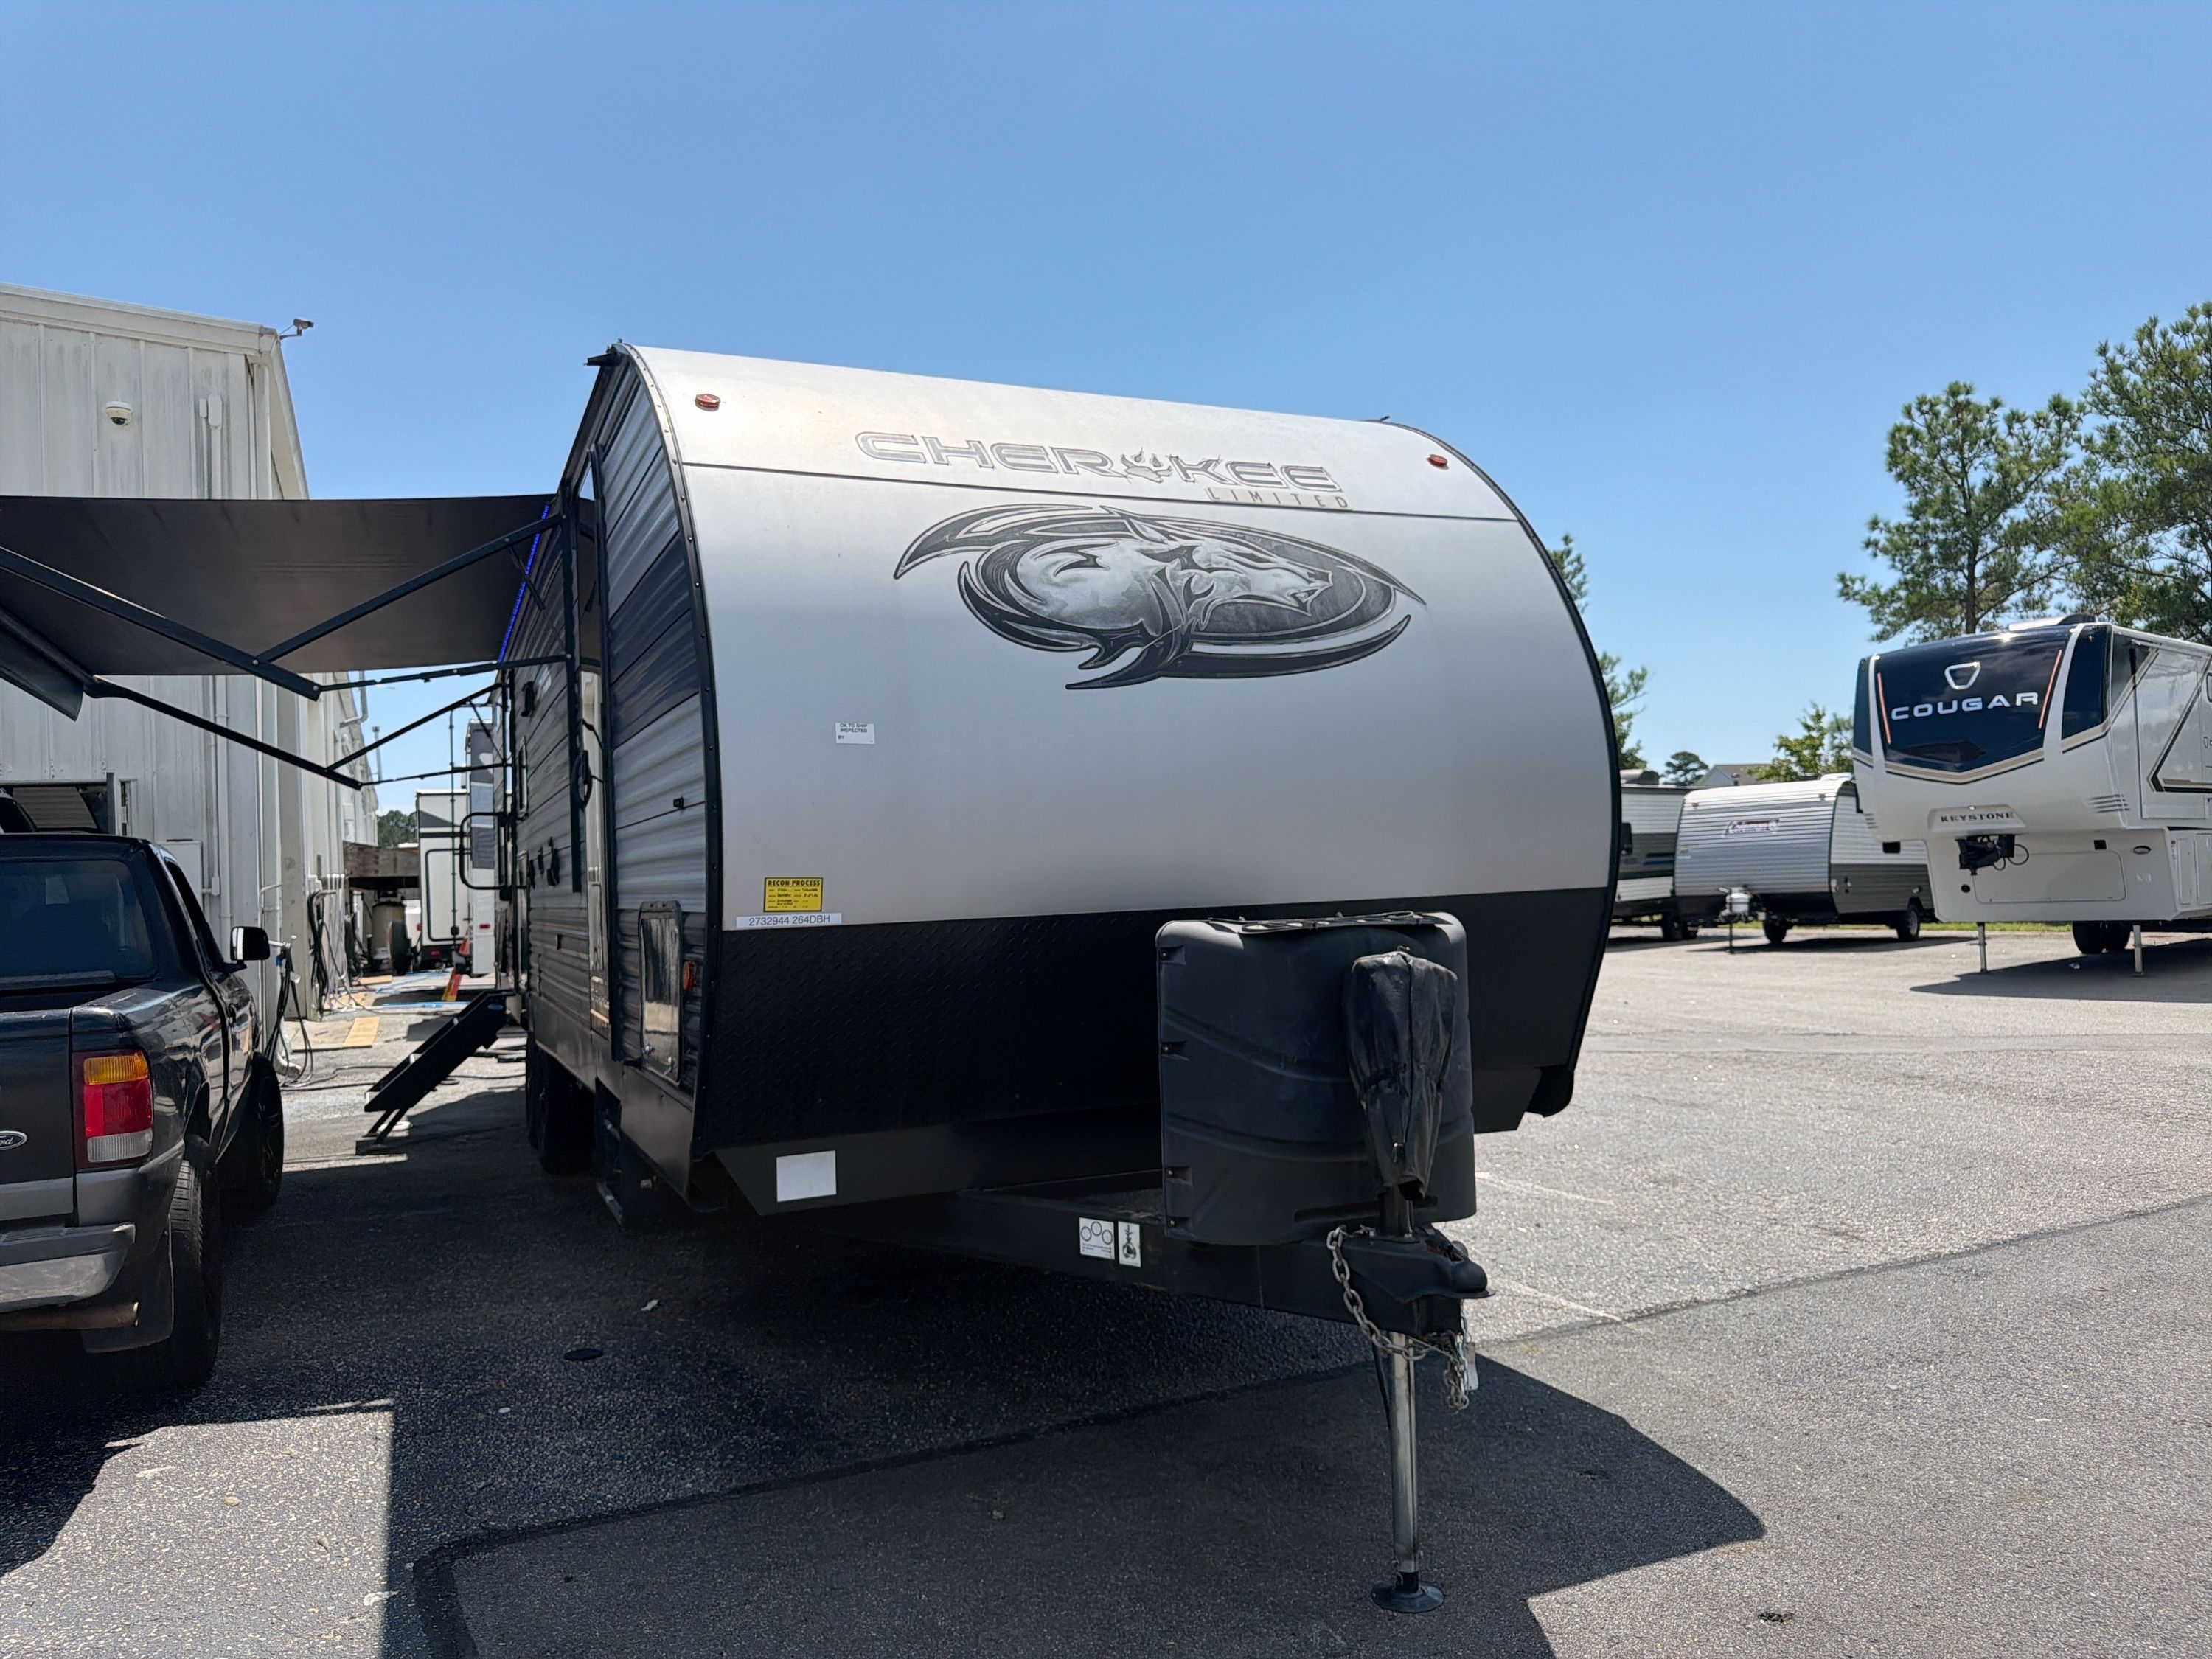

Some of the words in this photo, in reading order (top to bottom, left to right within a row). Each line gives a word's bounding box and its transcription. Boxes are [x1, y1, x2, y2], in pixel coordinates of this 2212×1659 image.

[1205, 487, 1348, 508] LIMITED
[1891, 692, 2039, 720] COUGAR
[1941, 812, 2016, 822] KEYSTONE
[748, 917, 789, 926] 2732944
[792, 915, 831, 924] 264DBH
